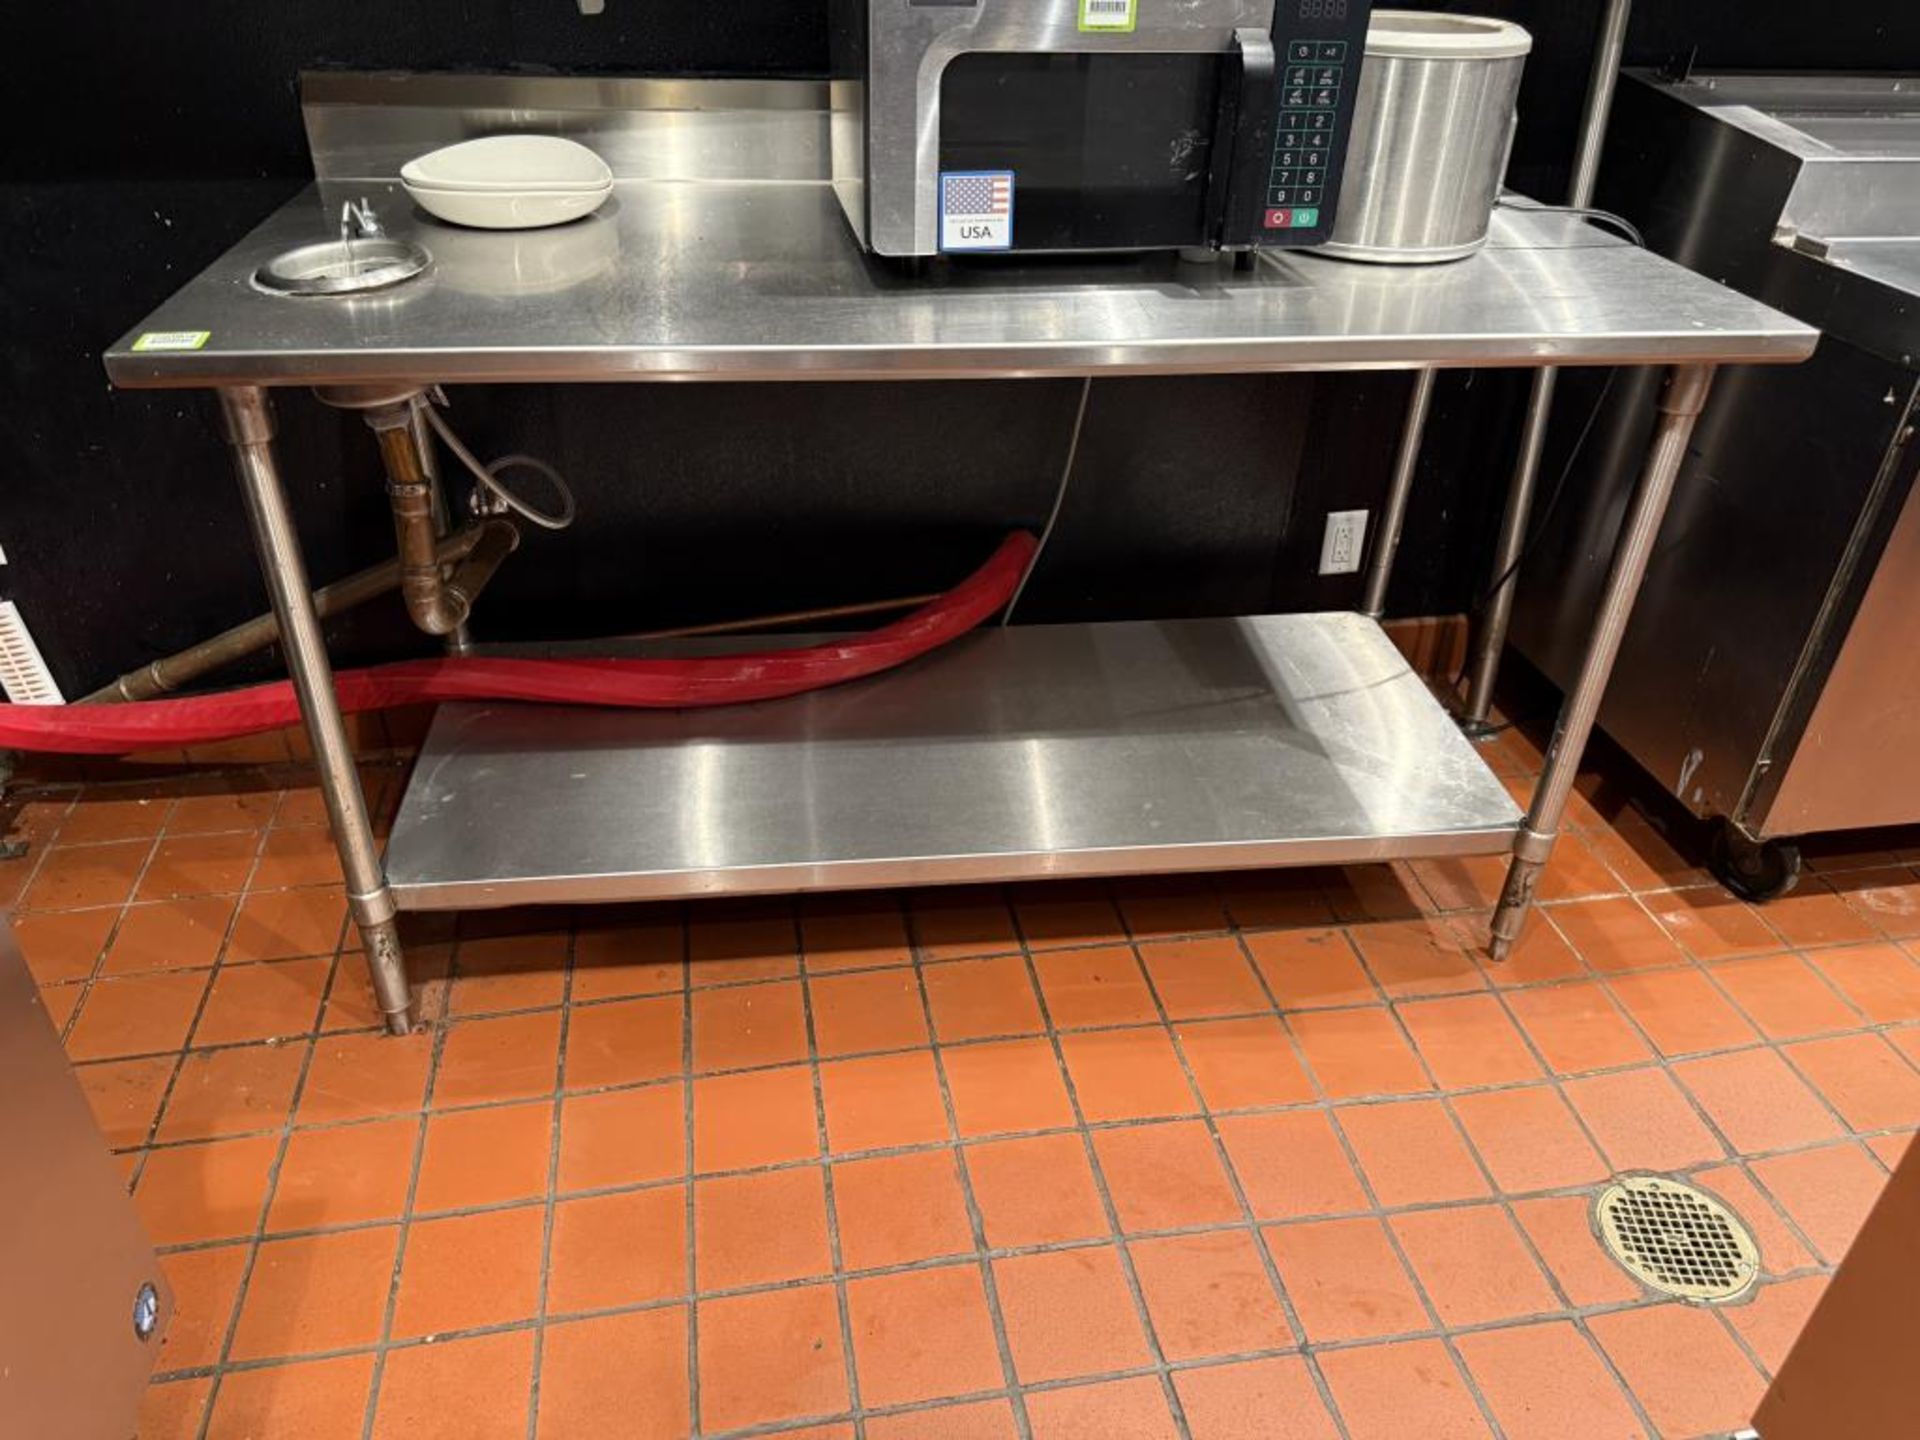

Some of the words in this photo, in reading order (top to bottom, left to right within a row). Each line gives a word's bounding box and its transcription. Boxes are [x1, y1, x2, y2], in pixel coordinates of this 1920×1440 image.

[1290, 116, 1295, 127] 1
[1315, 116, 1324, 127] 2
[1286, 135, 1294, 146] 3
[1312, 134, 1321, 145] 4
[1283, 154, 1291, 165] 5
[1309, 153, 1317, 164] 6
[1281, 172, 1288, 183] 7
[1306, 172, 1315, 183] 8
[1278, 191, 1285, 202] 9
[1304, 190, 1312, 201] 0
[960, 226, 992, 239] USA
